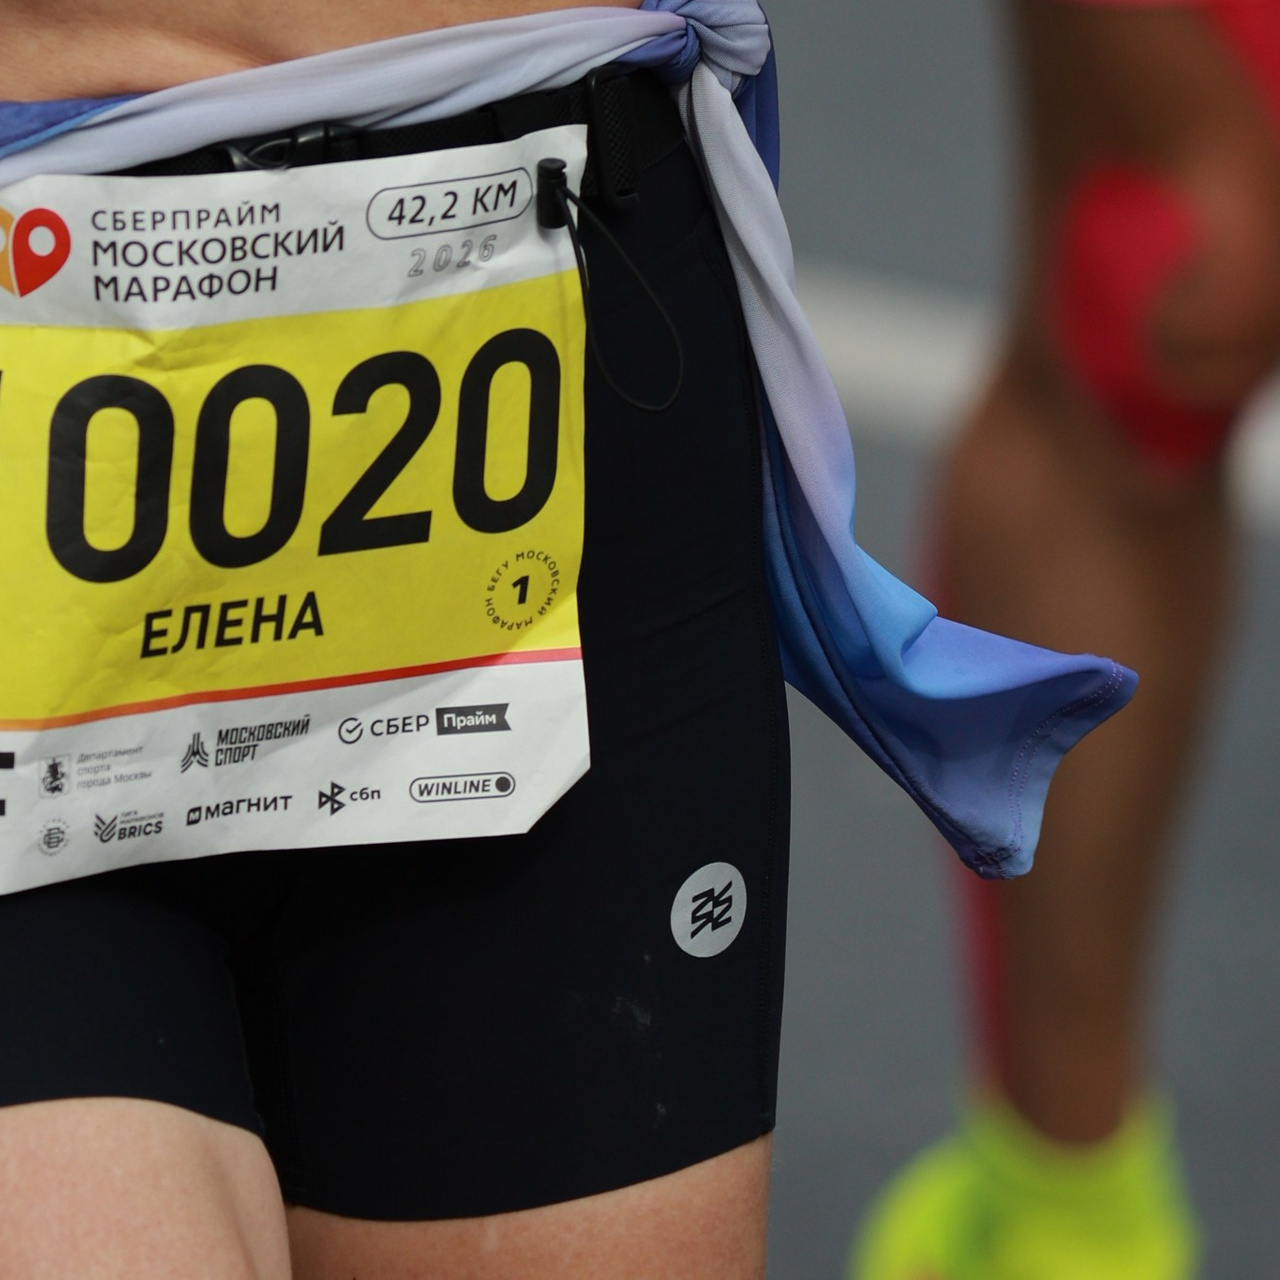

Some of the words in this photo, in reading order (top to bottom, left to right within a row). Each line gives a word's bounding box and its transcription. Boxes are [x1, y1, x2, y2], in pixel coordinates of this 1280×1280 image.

[91, 201, 280, 232] СБЕРПРАЙМ
[388, 191, 458, 226] 42,2
[472, 180, 518, 215] КМ
[92, 220, 345, 268] МОСКОВСКИЙ
[407, 234, 498, 278] 2026
[93, 266, 278, 303] МАРАФОН
[487, 560, 509, 592] БЕГУ
[512, 575, 530, 605] 1
[516, 550, 561, 616] МОСКОВСКИЙ
[141, 591, 325, 659] ЕЛЕНА
[485, 598, 534, 631] МАРАФОН
[216, 714, 311, 747] МОСКОВСКИЙ
[370, 715, 430, 736] СБЕР
[443, 710, 497, 730] Прайм
[215, 744, 259, 767] СПОРТ
[349, 787, 381, 801] сбп
[419, 779, 492, 797] WINLINE
[118, 820, 163, 840] BRICS
